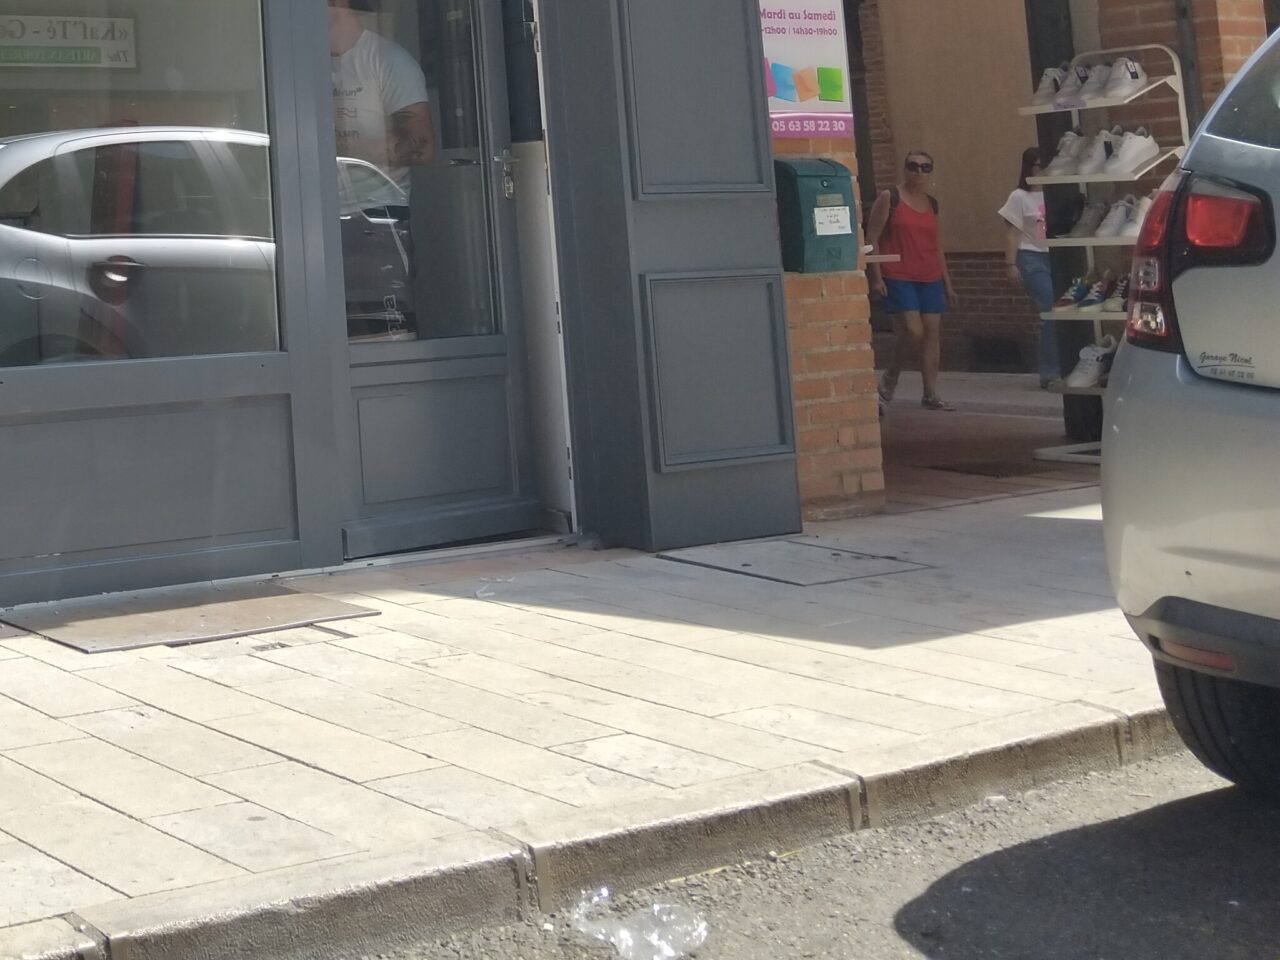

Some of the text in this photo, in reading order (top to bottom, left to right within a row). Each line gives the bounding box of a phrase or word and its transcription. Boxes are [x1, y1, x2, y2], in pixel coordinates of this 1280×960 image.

[788, 12, 800, 20] au
[803, 9, 836, 21] Samedi
[772, 120, 846, 132] 05 63 58 22 30
